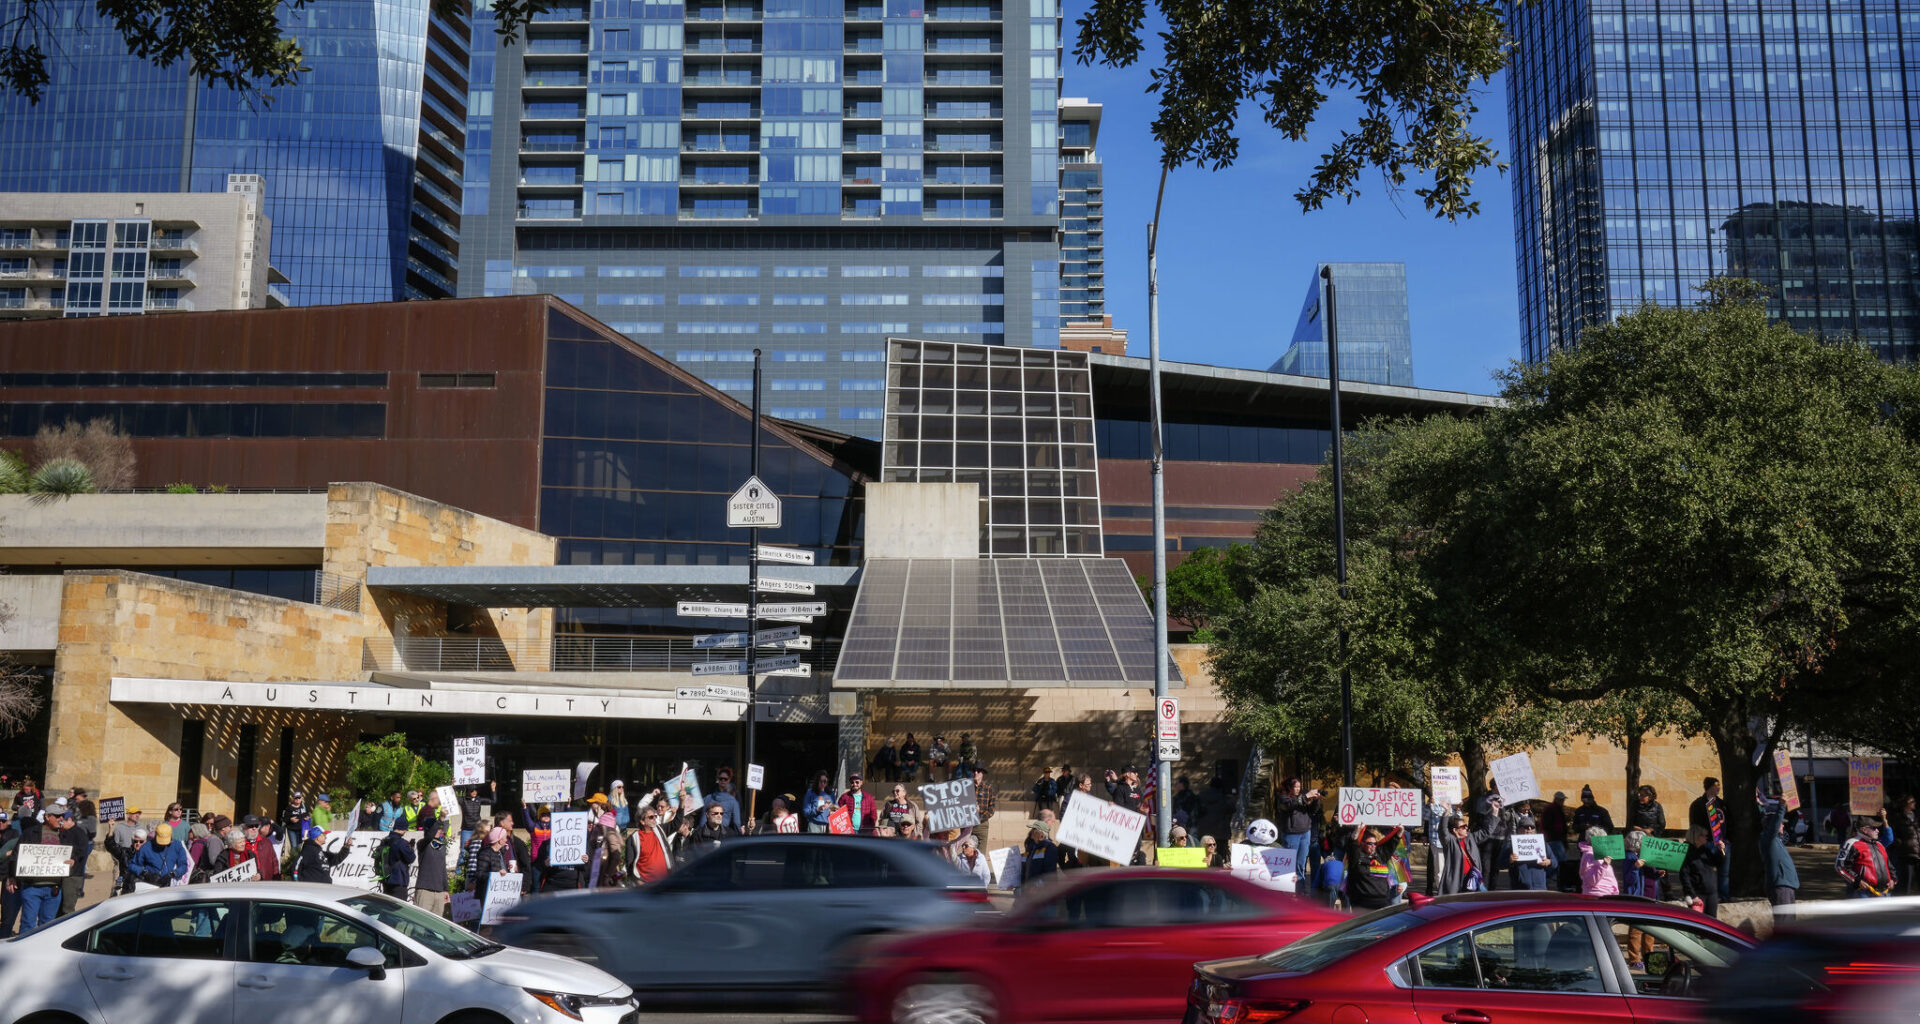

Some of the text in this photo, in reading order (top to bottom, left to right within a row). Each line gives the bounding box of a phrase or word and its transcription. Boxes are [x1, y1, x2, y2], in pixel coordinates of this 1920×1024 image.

[759, 550, 782, 558] Limerick
[760, 579, 806, 590] Angers 5015mi
[714, 606, 732, 614] Chiang
[703, 665, 726, 673] 6988mi
[222, 686, 774, 718] AUSTIN CITY HALL
[455, 738, 485, 747] ICE NOT
[457, 747, 479, 756] NEEDED
[1850, 760, 1881, 773] TRUMP
[524, 782, 541, 792] ICE
[1850, 776, 1882, 786] BLOOD
[923, 778, 973, 805] STOP
[1344, 788, 1415, 802] NO Justice
[99, 799, 124, 808] HATE WILL
[940, 796, 961, 807] THE
[1356, 801, 1418, 817] NO PEACE
[928, 804, 981, 831] MURDER
[1099, 804, 1142, 832] WRONG!
[555, 817, 582, 833] ICE
[554, 835, 582, 848] KILLED
[22, 845, 69, 856] PROSECUTE
[1669, 842, 1689, 854] ICE
[33, 856, 55, 865] ICE
[555, 847, 581, 863] GOOD
[1241, 852, 1292, 866] ABOLISH
[18, 865, 66, 876] MURDERERS
[215, 870, 233, 883] THE
[236, 863, 251, 874] TIP
[1247, 868, 1281, 882] ICE
[490, 879, 521, 893] VETERAN
[491, 896, 517, 907] AGAINST
